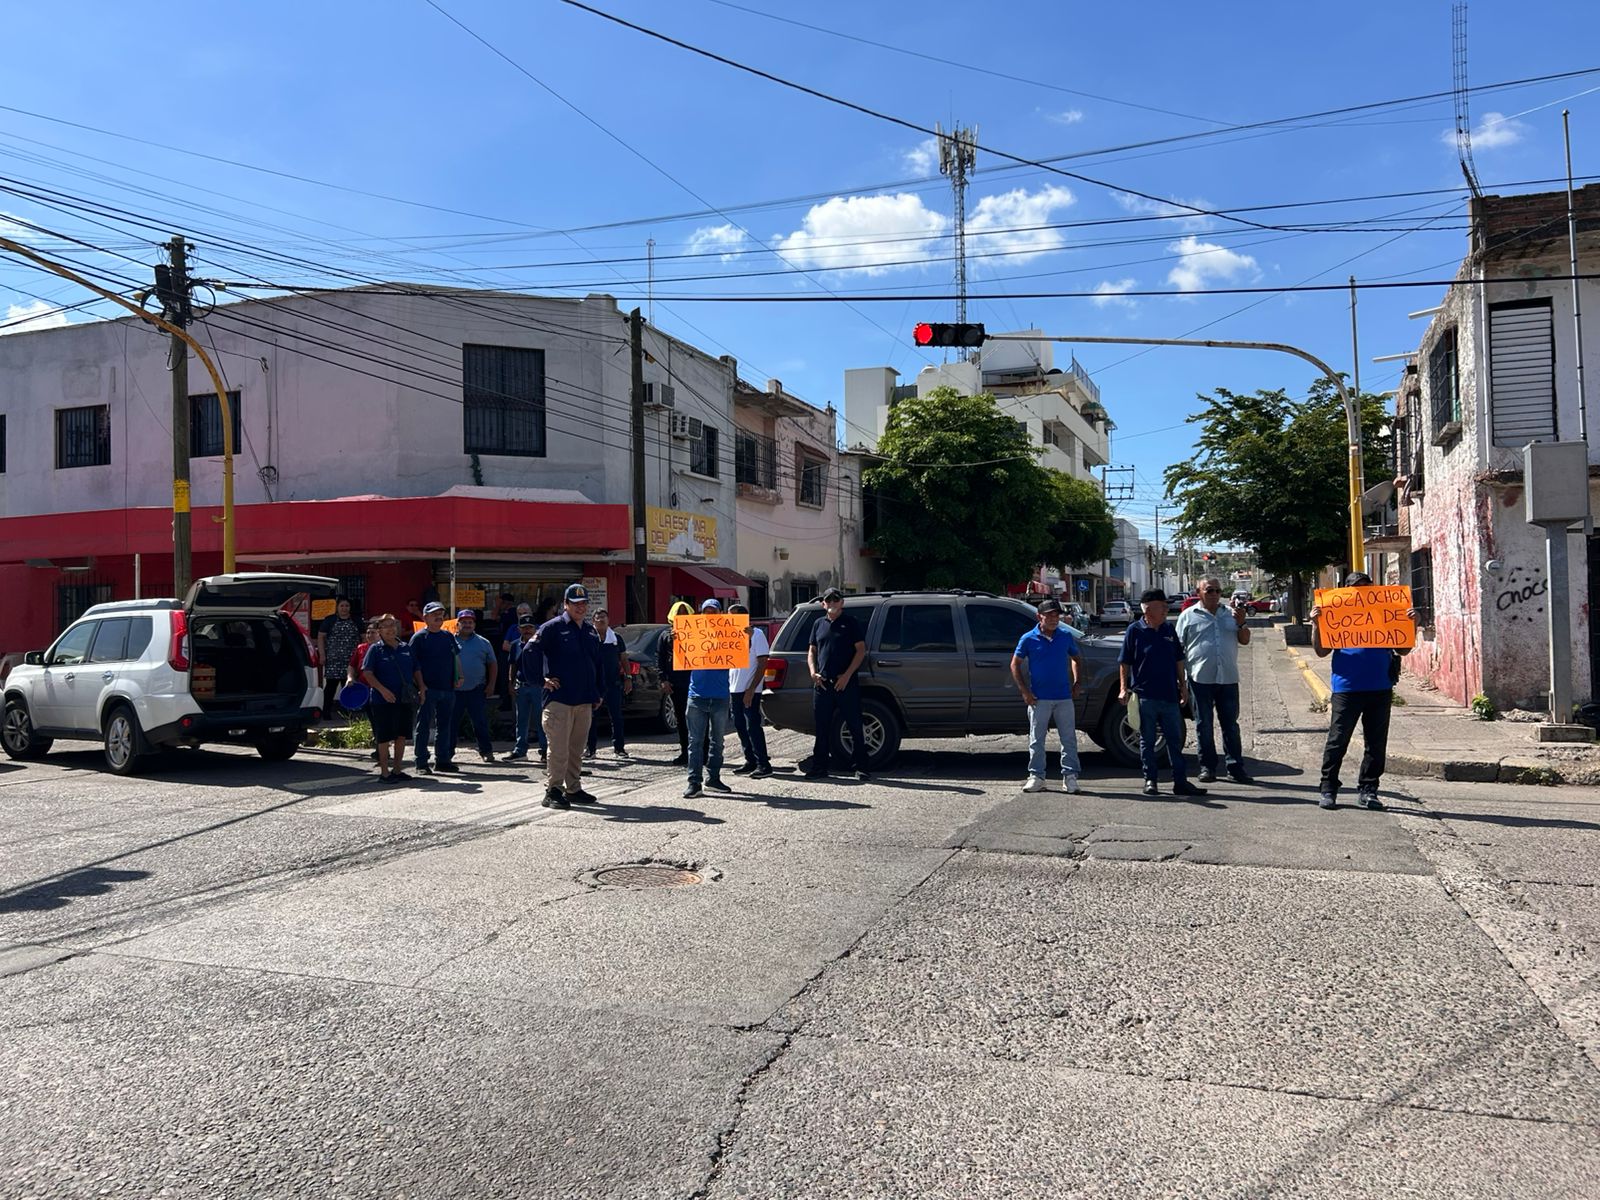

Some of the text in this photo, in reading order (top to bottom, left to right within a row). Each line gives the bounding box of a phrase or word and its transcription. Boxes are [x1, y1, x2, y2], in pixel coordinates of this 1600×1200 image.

[1319, 590, 1410, 609] LOZA OCHOA
[675, 617, 740, 630] LA FISCAL
[1325, 609, 1408, 630] GOZA DE
[677, 631, 693, 641] DE
[1327, 629, 1407, 648] IMPUNIDAD
[678, 640, 742, 653] NO QUIERE
[684, 655, 736, 669] ACTUAR
